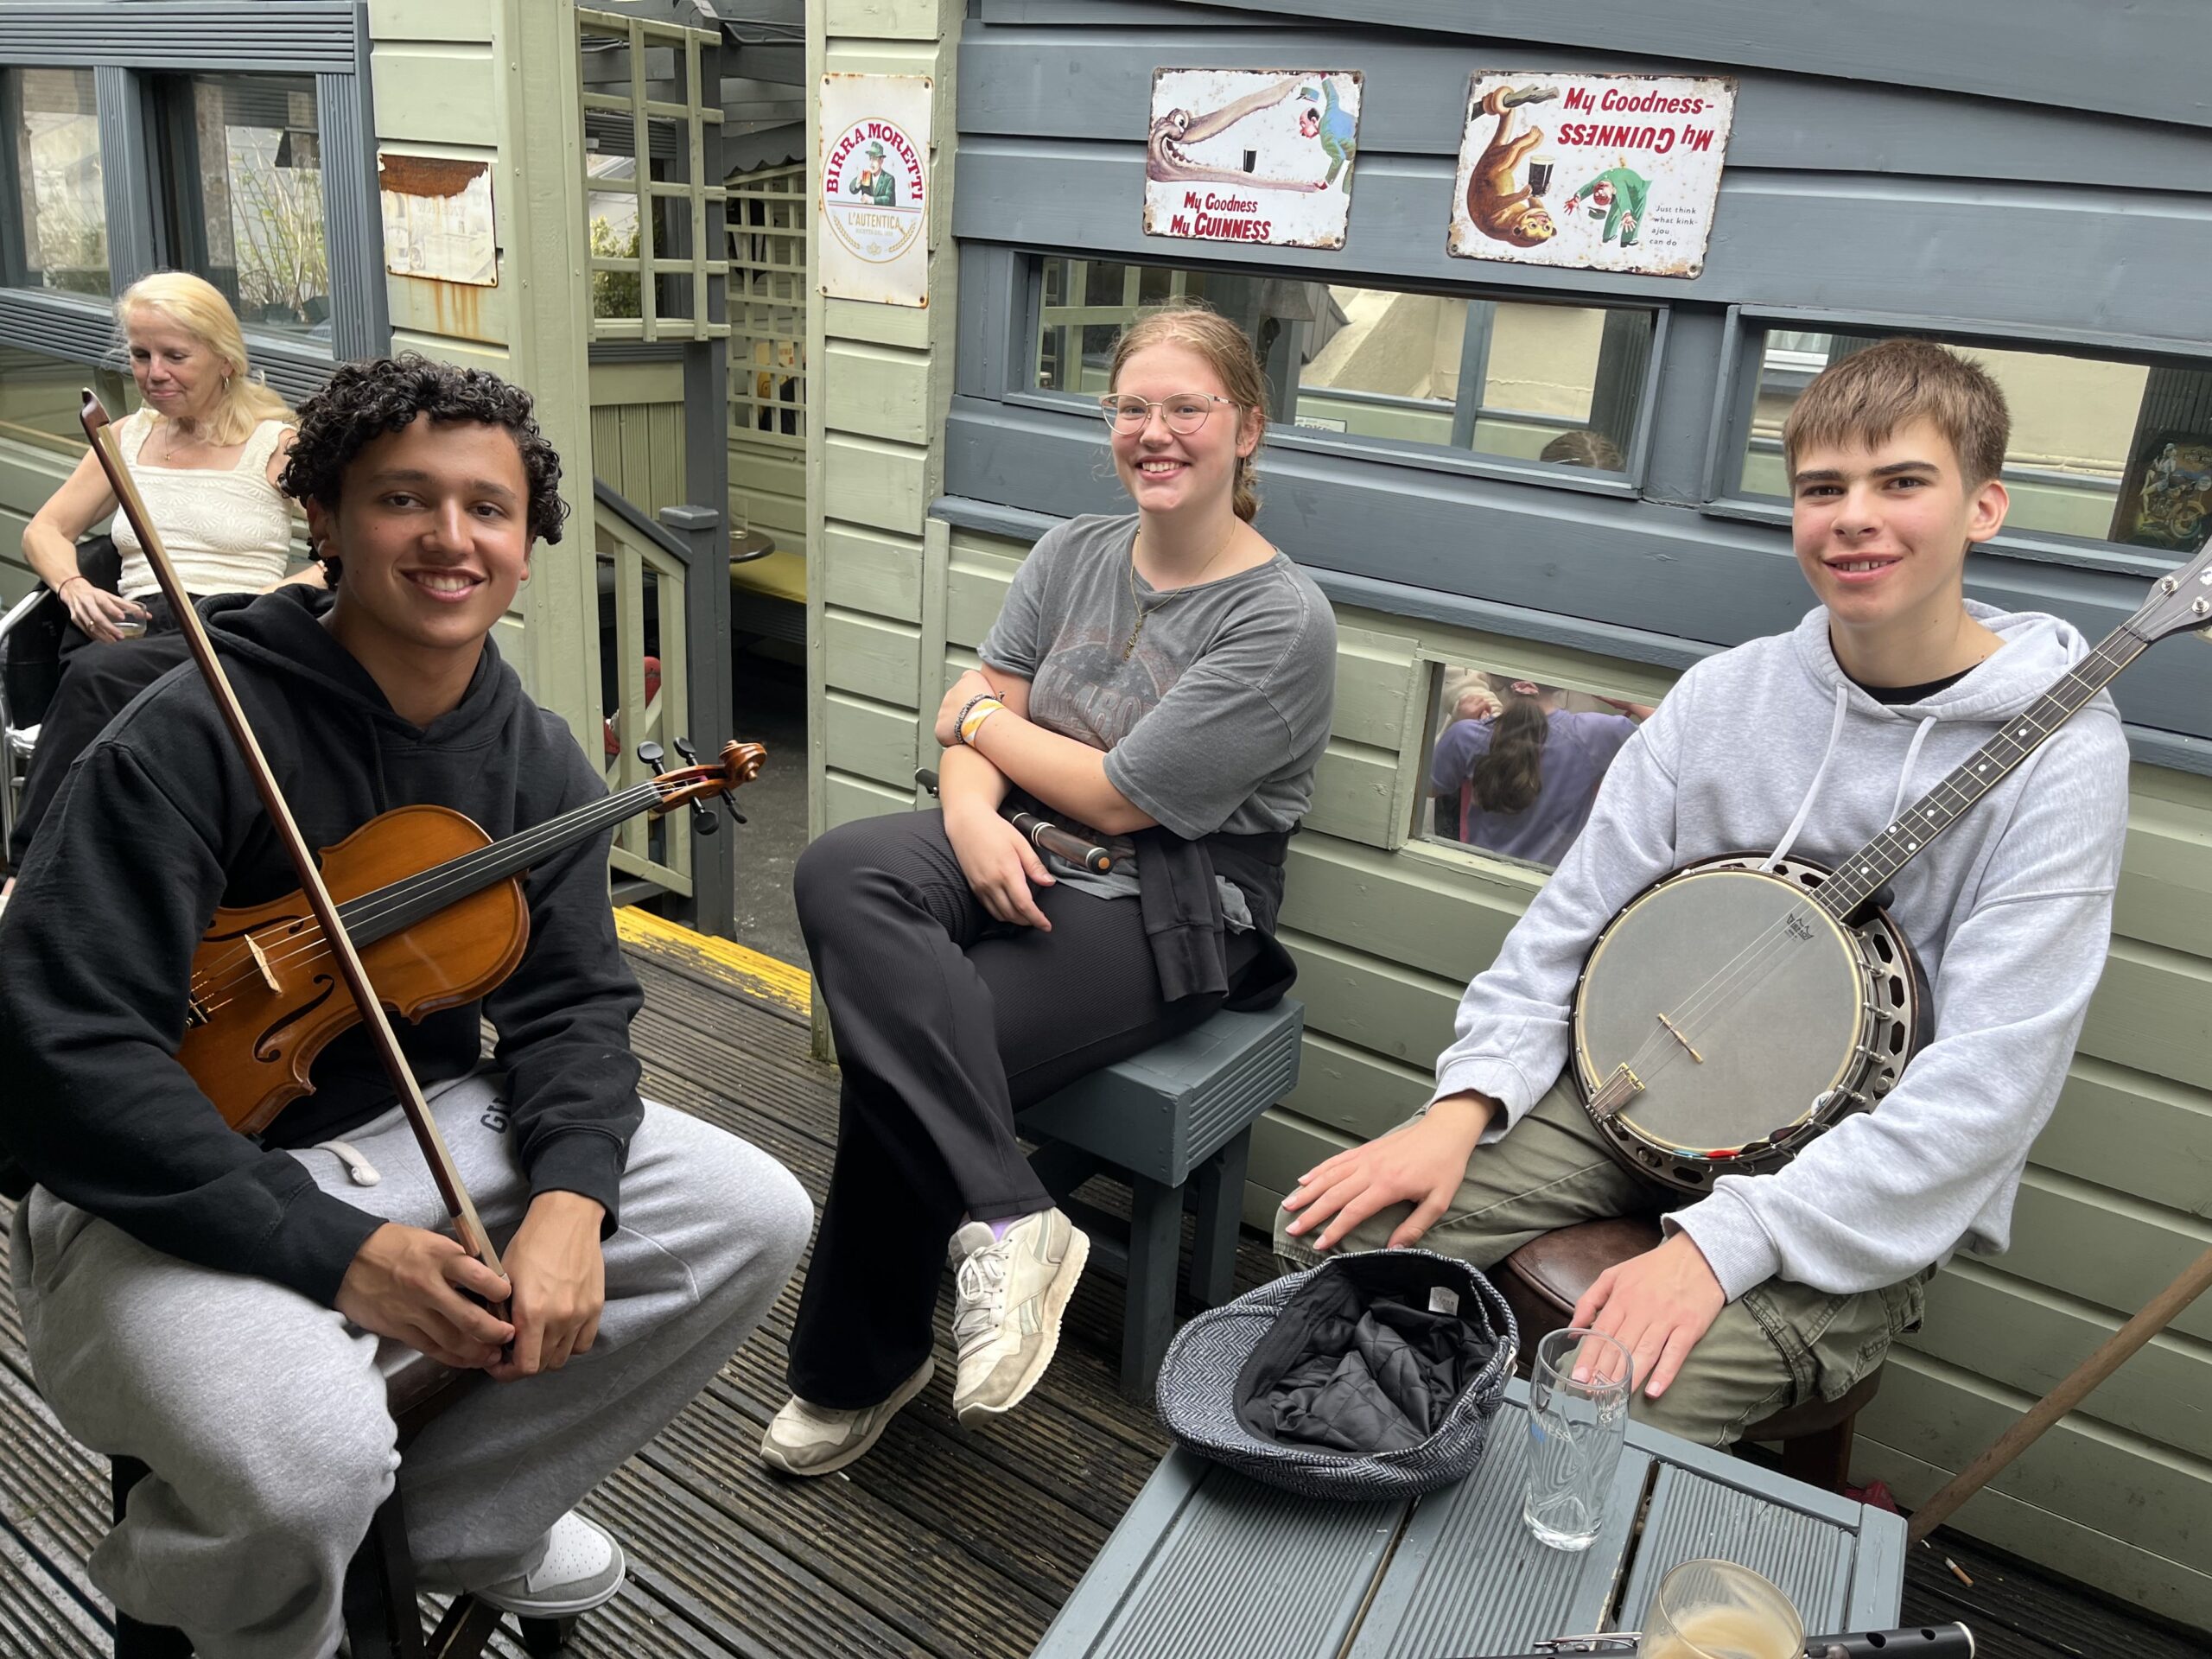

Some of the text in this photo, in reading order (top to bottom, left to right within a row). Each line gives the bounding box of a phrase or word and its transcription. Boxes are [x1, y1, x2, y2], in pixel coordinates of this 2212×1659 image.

[1563, 87, 1714, 116] My Goodness-
[1558, 124, 1714, 154] My GUINNESS
[826, 123, 923, 200] BIRRA MORETTI
[1184, 191, 1258, 213] My Goodness
[1675, 206, 1696, 214] think
[849, 212, 899, 229] L'AUTENTICA
[1170, 213, 1271, 239] My GUINNESS
